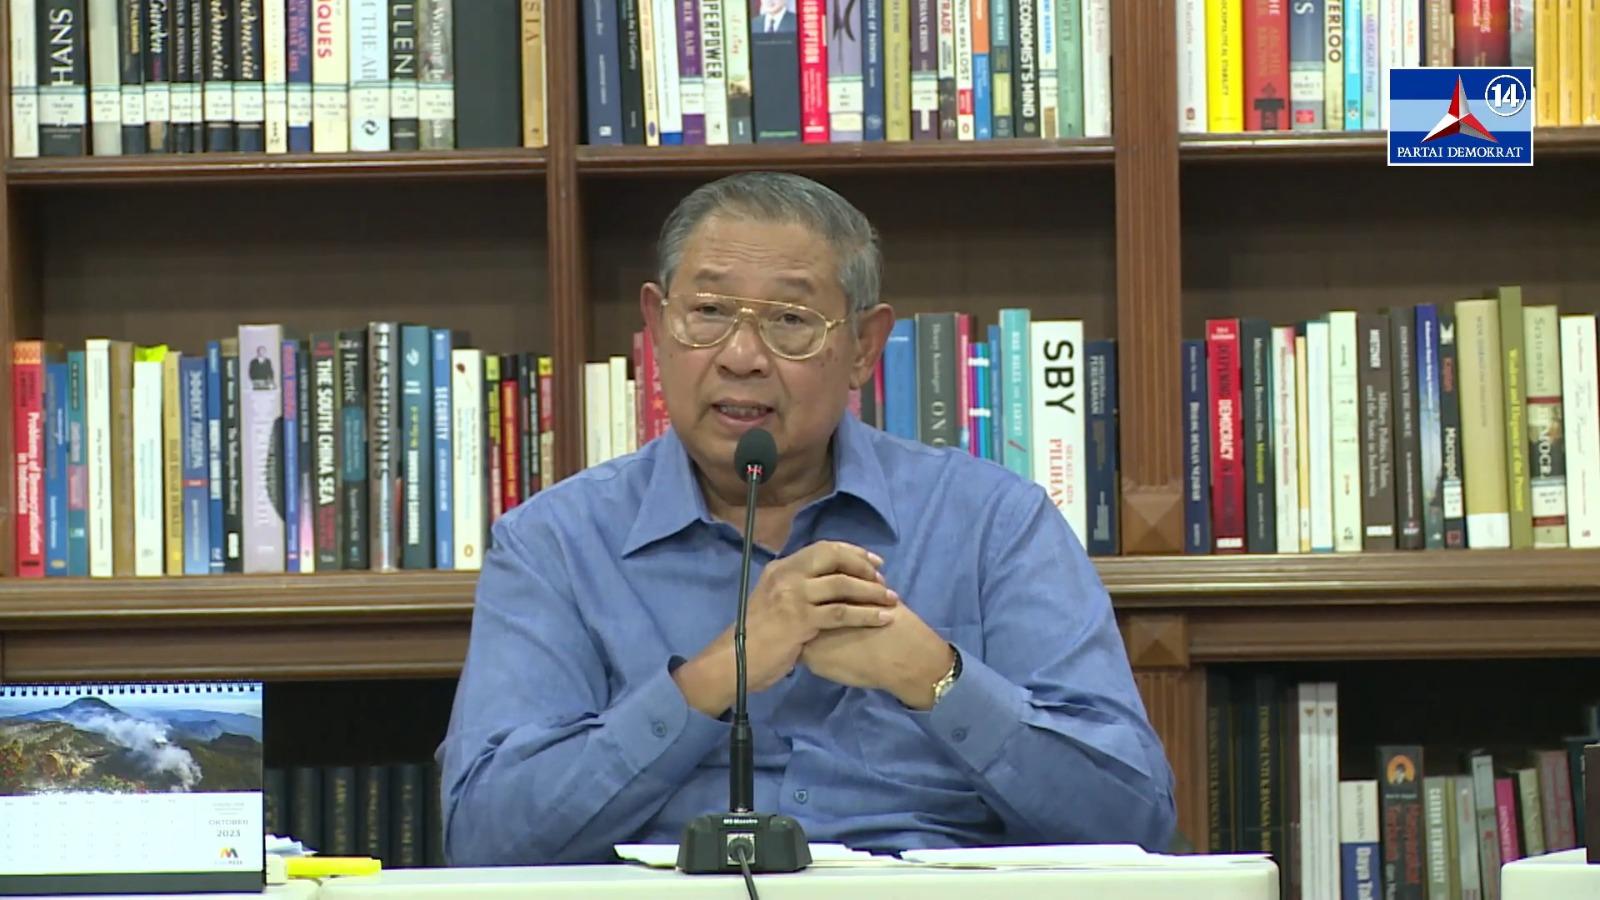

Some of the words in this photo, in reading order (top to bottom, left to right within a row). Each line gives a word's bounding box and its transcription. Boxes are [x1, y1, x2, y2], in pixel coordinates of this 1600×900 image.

[50, 9, 75, 87] HANS
[1022, 83, 1036, 118] MIND
[317, 360, 332, 386] THE
[344, 354, 360, 403] Heretic
[1044, 340, 1076, 414] SBY
[1508, 350, 1519, 387] Wisdom
[318, 388, 333, 433] SOUTH
[373, 331, 391, 480] FLASHPOINTS
[435, 386, 449, 440] SECURITY
[931, 401, 947, 430] ON
[1509, 388, 1520, 405] and
[28, 412, 41, 457] Problems
[1219, 399, 1233, 460] DEMOCRACY
[1508, 406, 1521, 447] Elegance
[29, 460, 42, 472] of
[319, 435, 334, 475] CHINA
[1368, 454, 1378, 497] Indonesia
[17, 464, 28, 514] Indonesia
[319, 477, 334, 504] SEA
[216, 829, 241, 837] 2023
[1356, 846, 1371, 880] Daya
